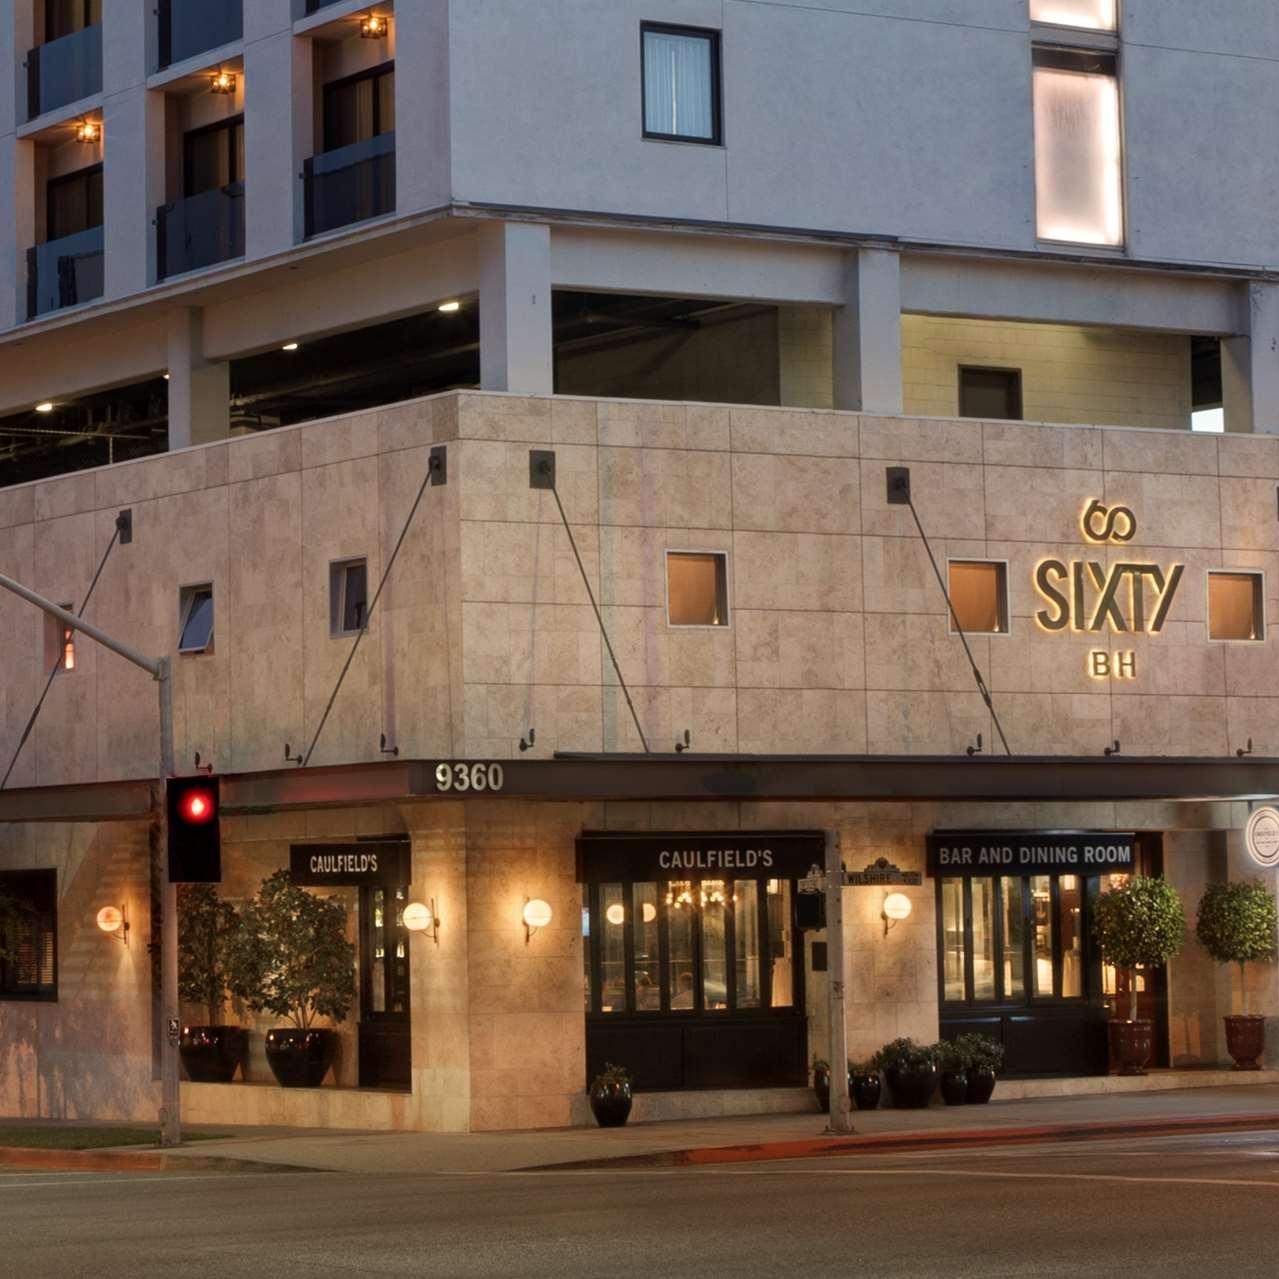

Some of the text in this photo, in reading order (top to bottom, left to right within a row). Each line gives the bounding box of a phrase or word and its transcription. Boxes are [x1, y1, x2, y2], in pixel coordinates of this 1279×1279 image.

[1035, 558, 1186, 633] SIXTY
[1090, 650, 1137, 678] BH
[435, 762, 504, 792] 9360
[310, 854, 378, 873] CAULFIELD'S
[659, 849, 774, 869] CAULFIELD'S
[939, 846, 1131, 864] BAR AND DINING ROOM
